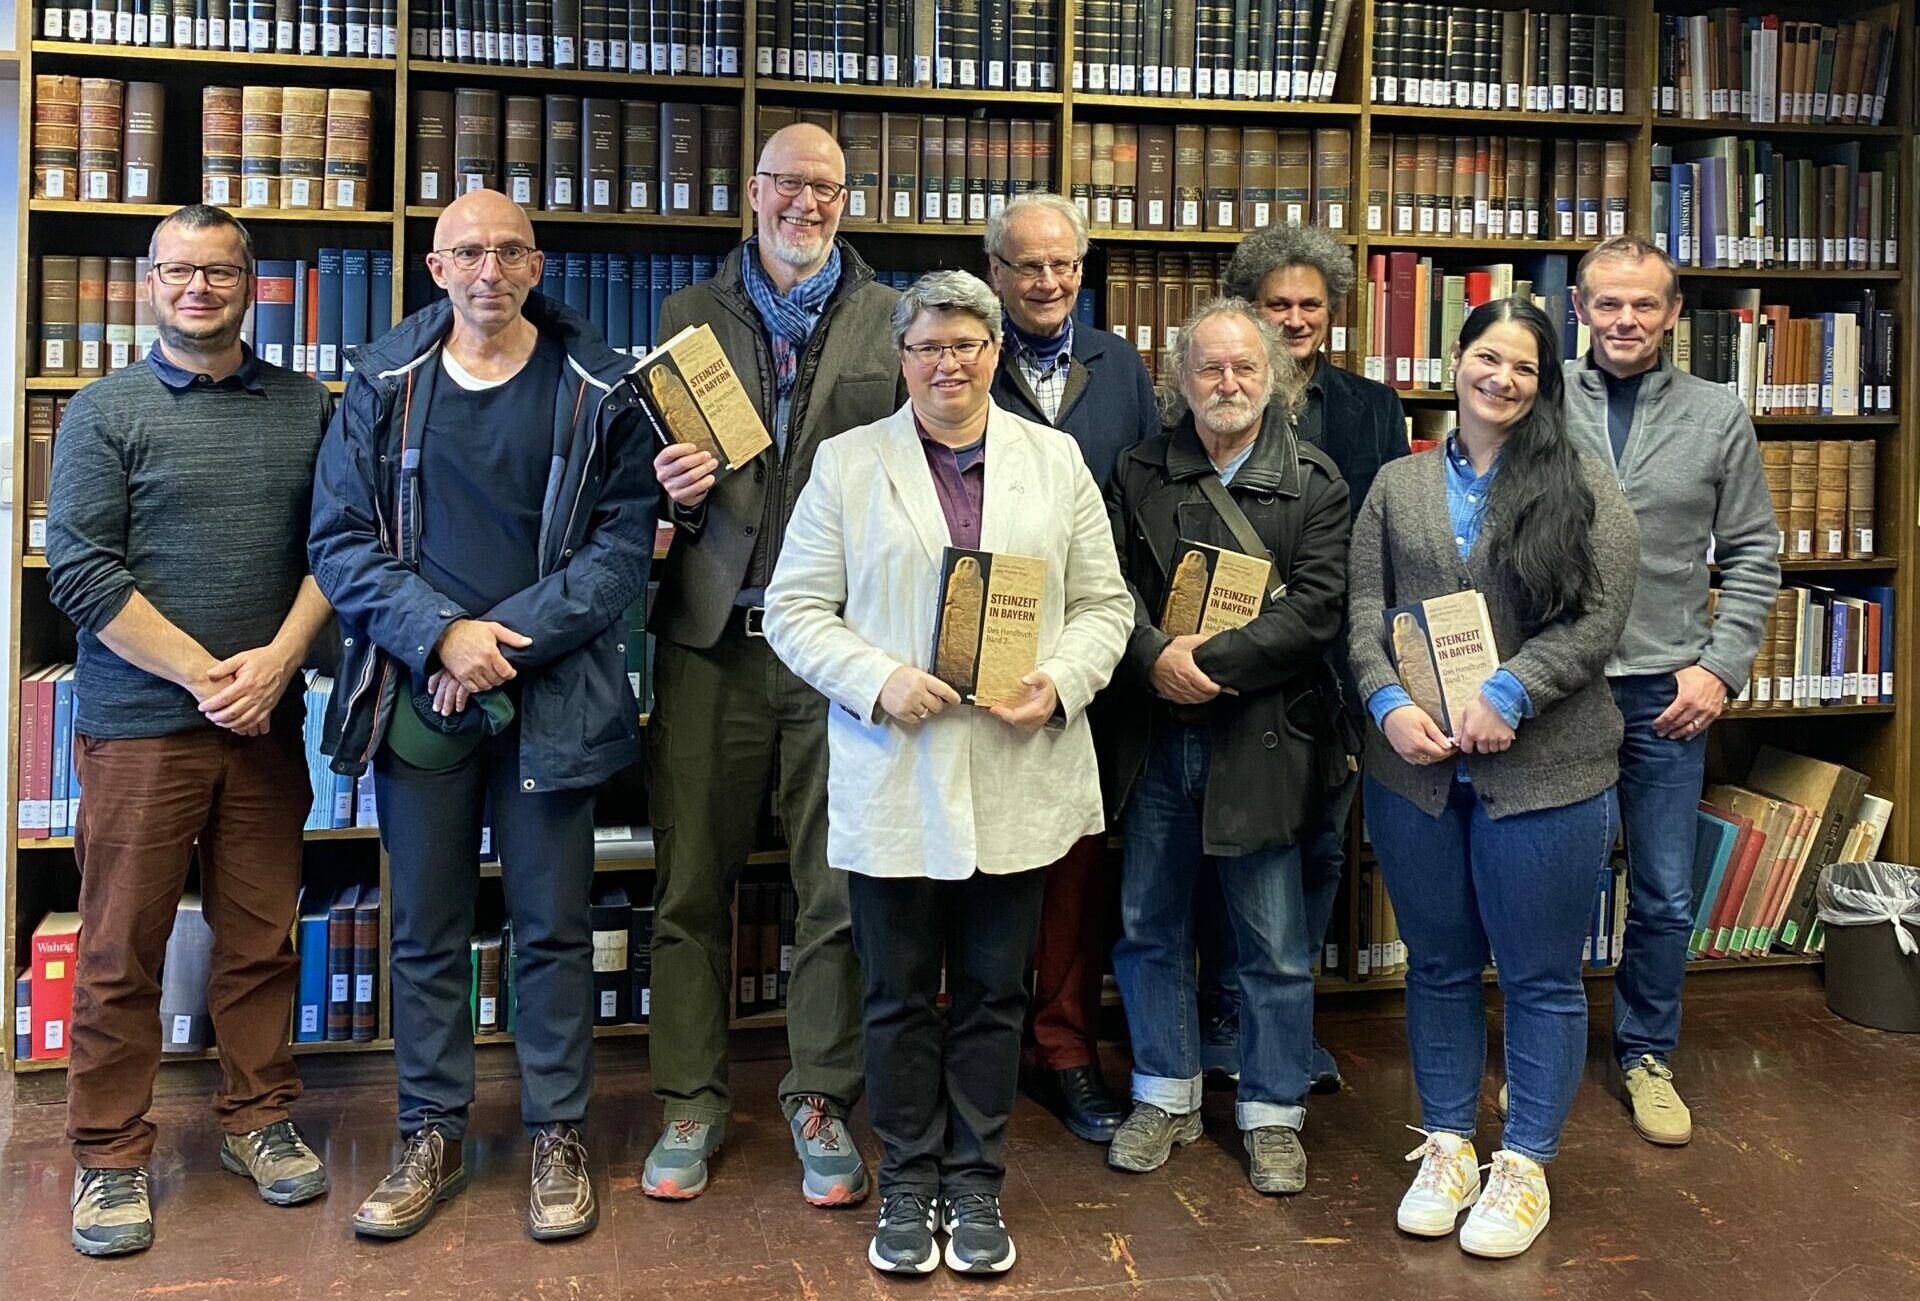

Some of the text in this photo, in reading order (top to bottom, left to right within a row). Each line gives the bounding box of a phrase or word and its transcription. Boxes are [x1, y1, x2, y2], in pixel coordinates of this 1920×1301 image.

[689, 358, 725, 388] STEINZEIT
[695, 370, 731, 399] IN BAYERN
[991, 593, 1038, 609] STEINZEIT
[1213, 587, 1257, 606] STEINZEIT
[989, 607, 1036, 622] IN BAYERN
[1210, 599, 1254, 617] IN BAYERN
[1435, 629, 1480, 648] STEINZEIT
[1438, 642, 1484, 660] IN BAYERN
[36, 941, 75, 954] Wahrig
